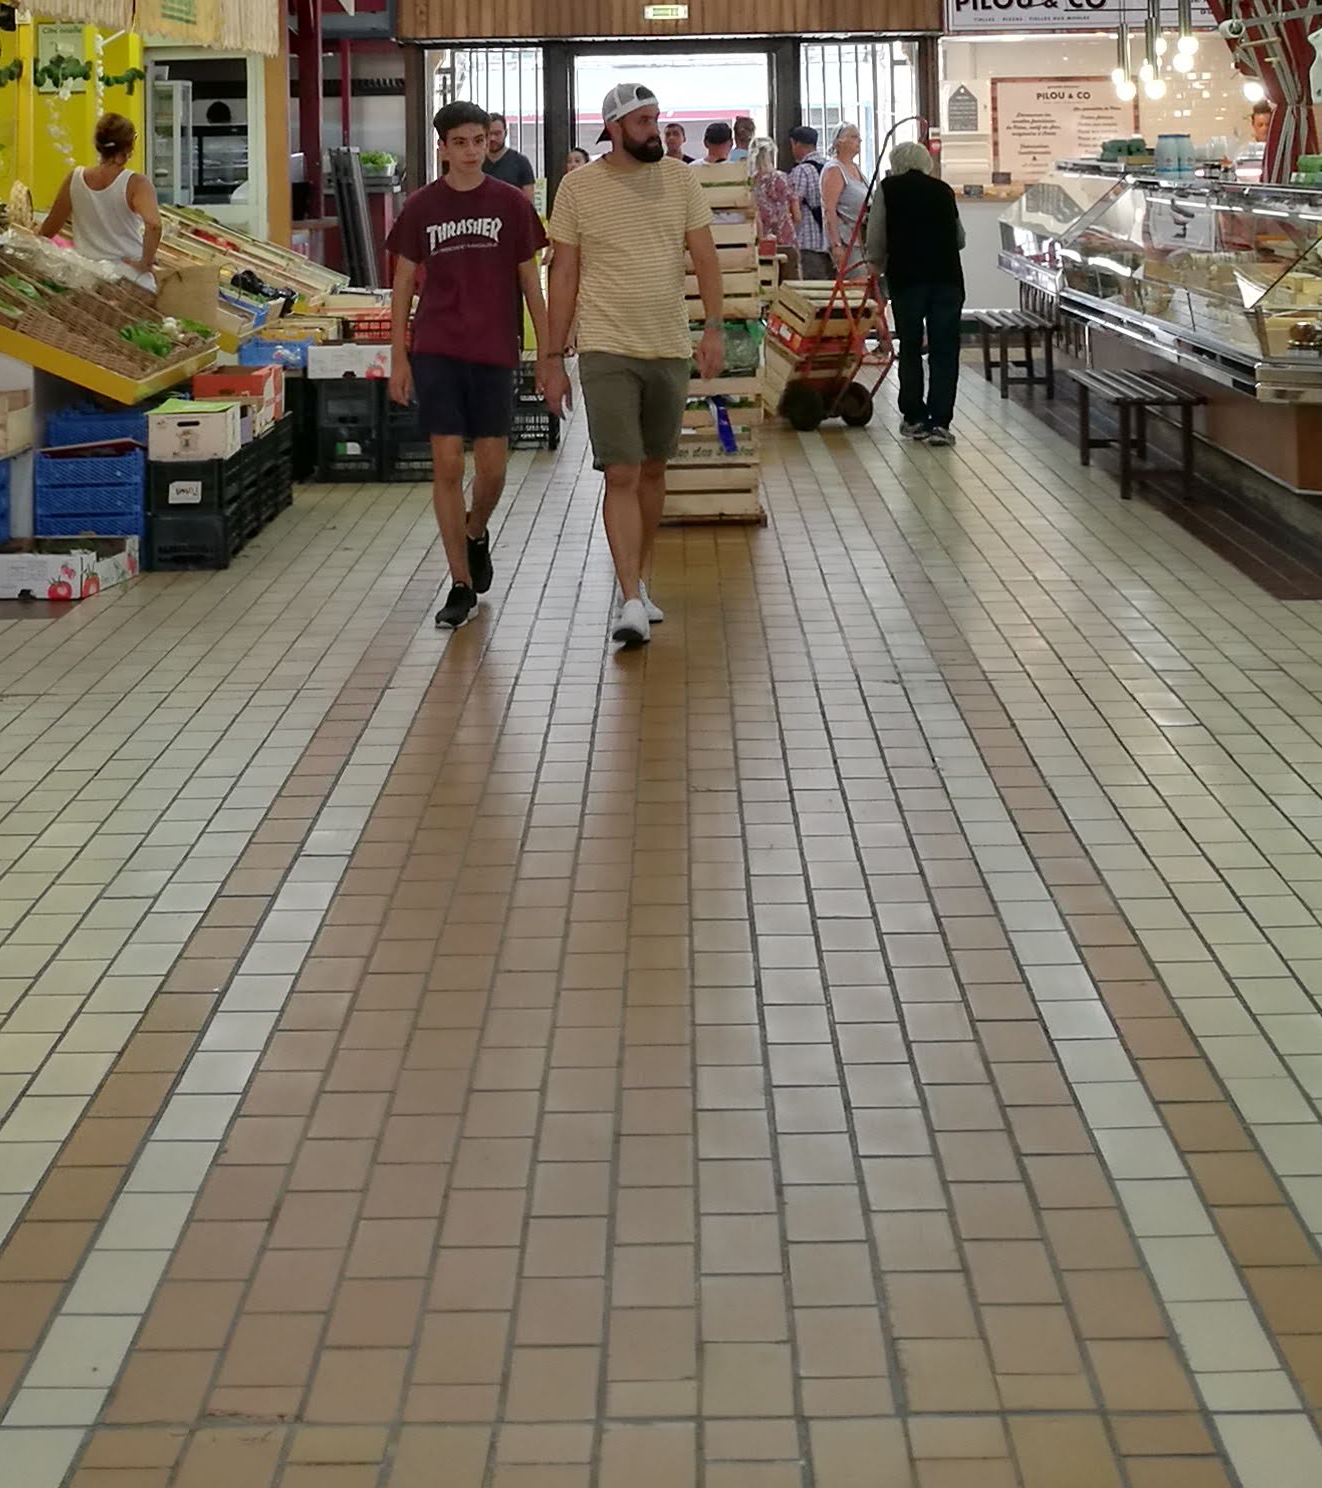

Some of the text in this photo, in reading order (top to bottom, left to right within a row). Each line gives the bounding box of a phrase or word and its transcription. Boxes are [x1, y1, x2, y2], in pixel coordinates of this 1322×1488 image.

[1036, 91, 1065, 100] PILOU
[1077, 91, 1091, 100] CO
[426, 217, 503, 252] THRASHER
